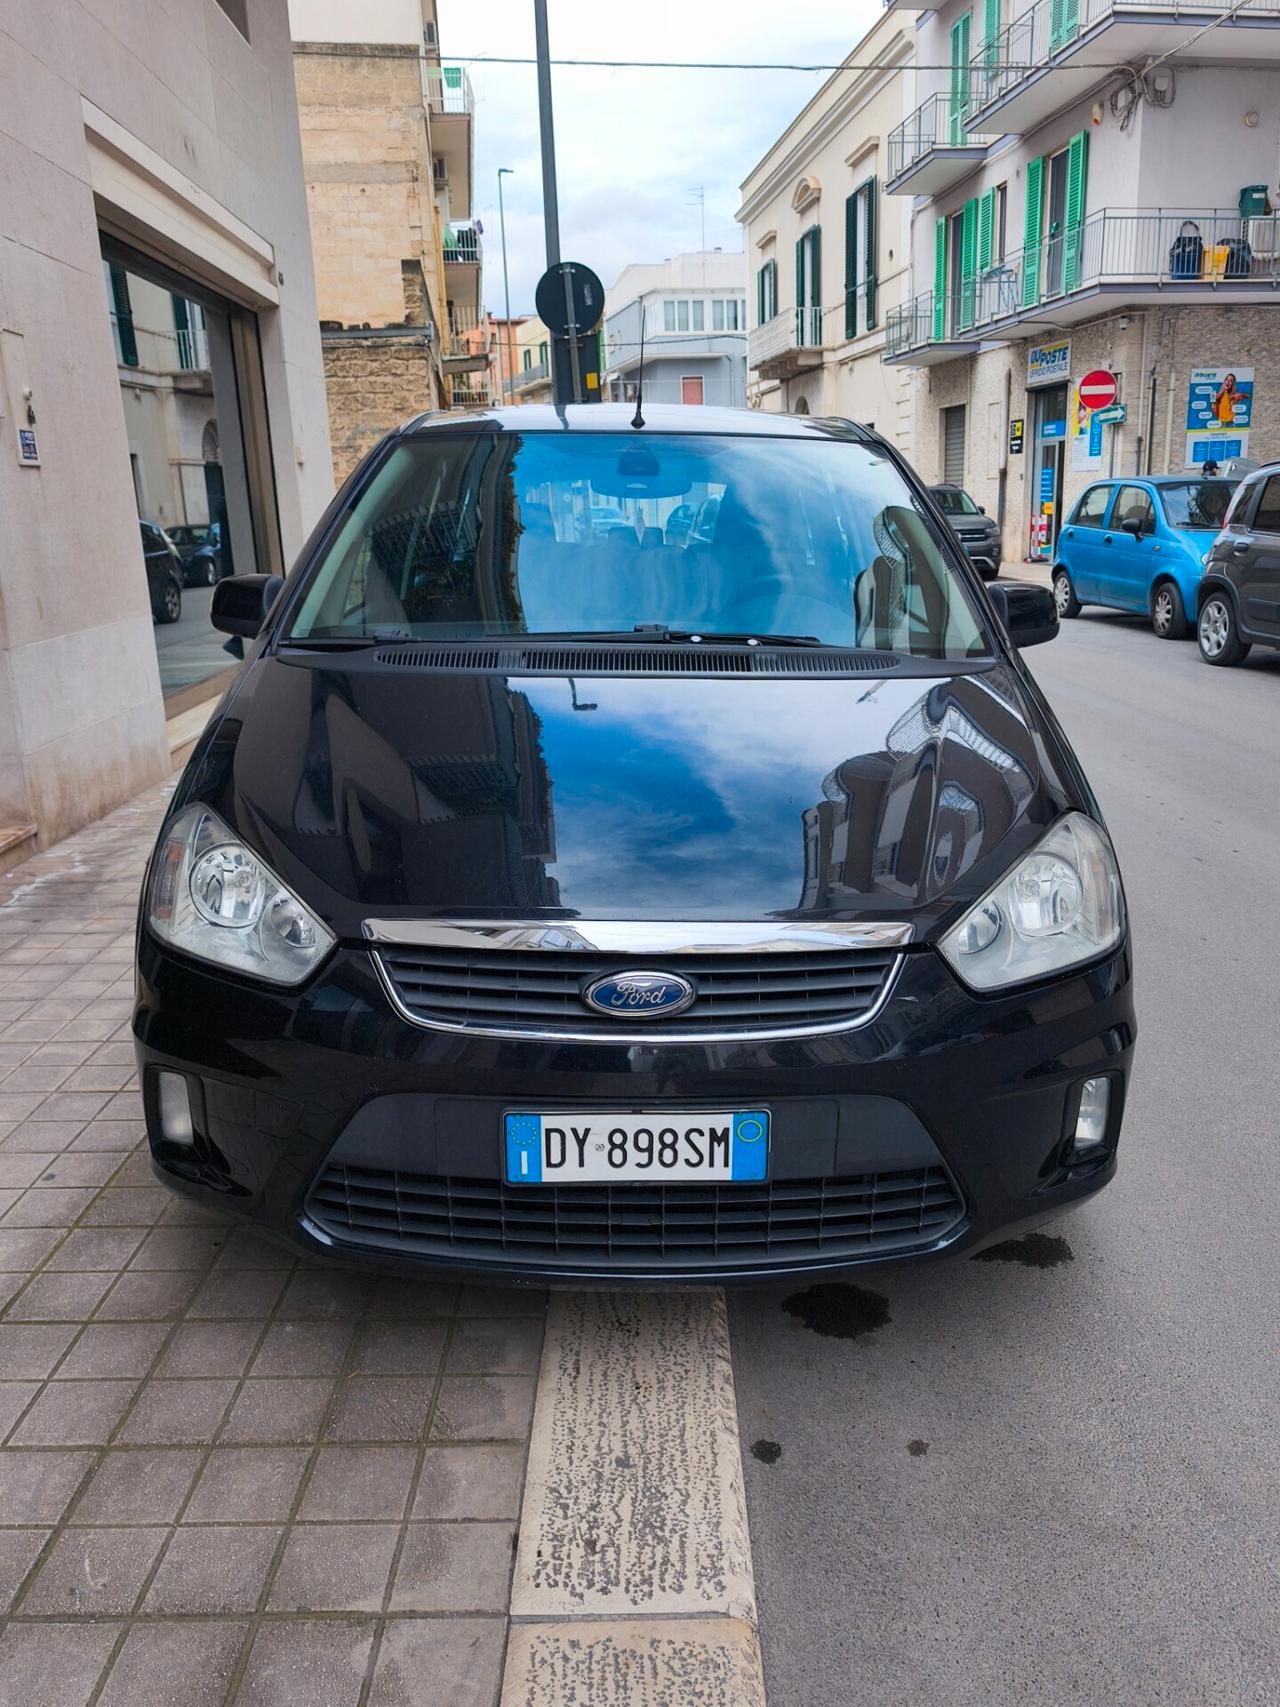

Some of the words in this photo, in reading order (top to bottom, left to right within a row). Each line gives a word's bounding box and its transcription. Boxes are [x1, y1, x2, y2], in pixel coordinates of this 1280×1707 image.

[611, 981, 666, 1006] Ford
[544, 1127, 592, 1169] DY
[607, 1127, 731, 1169] 898SM
